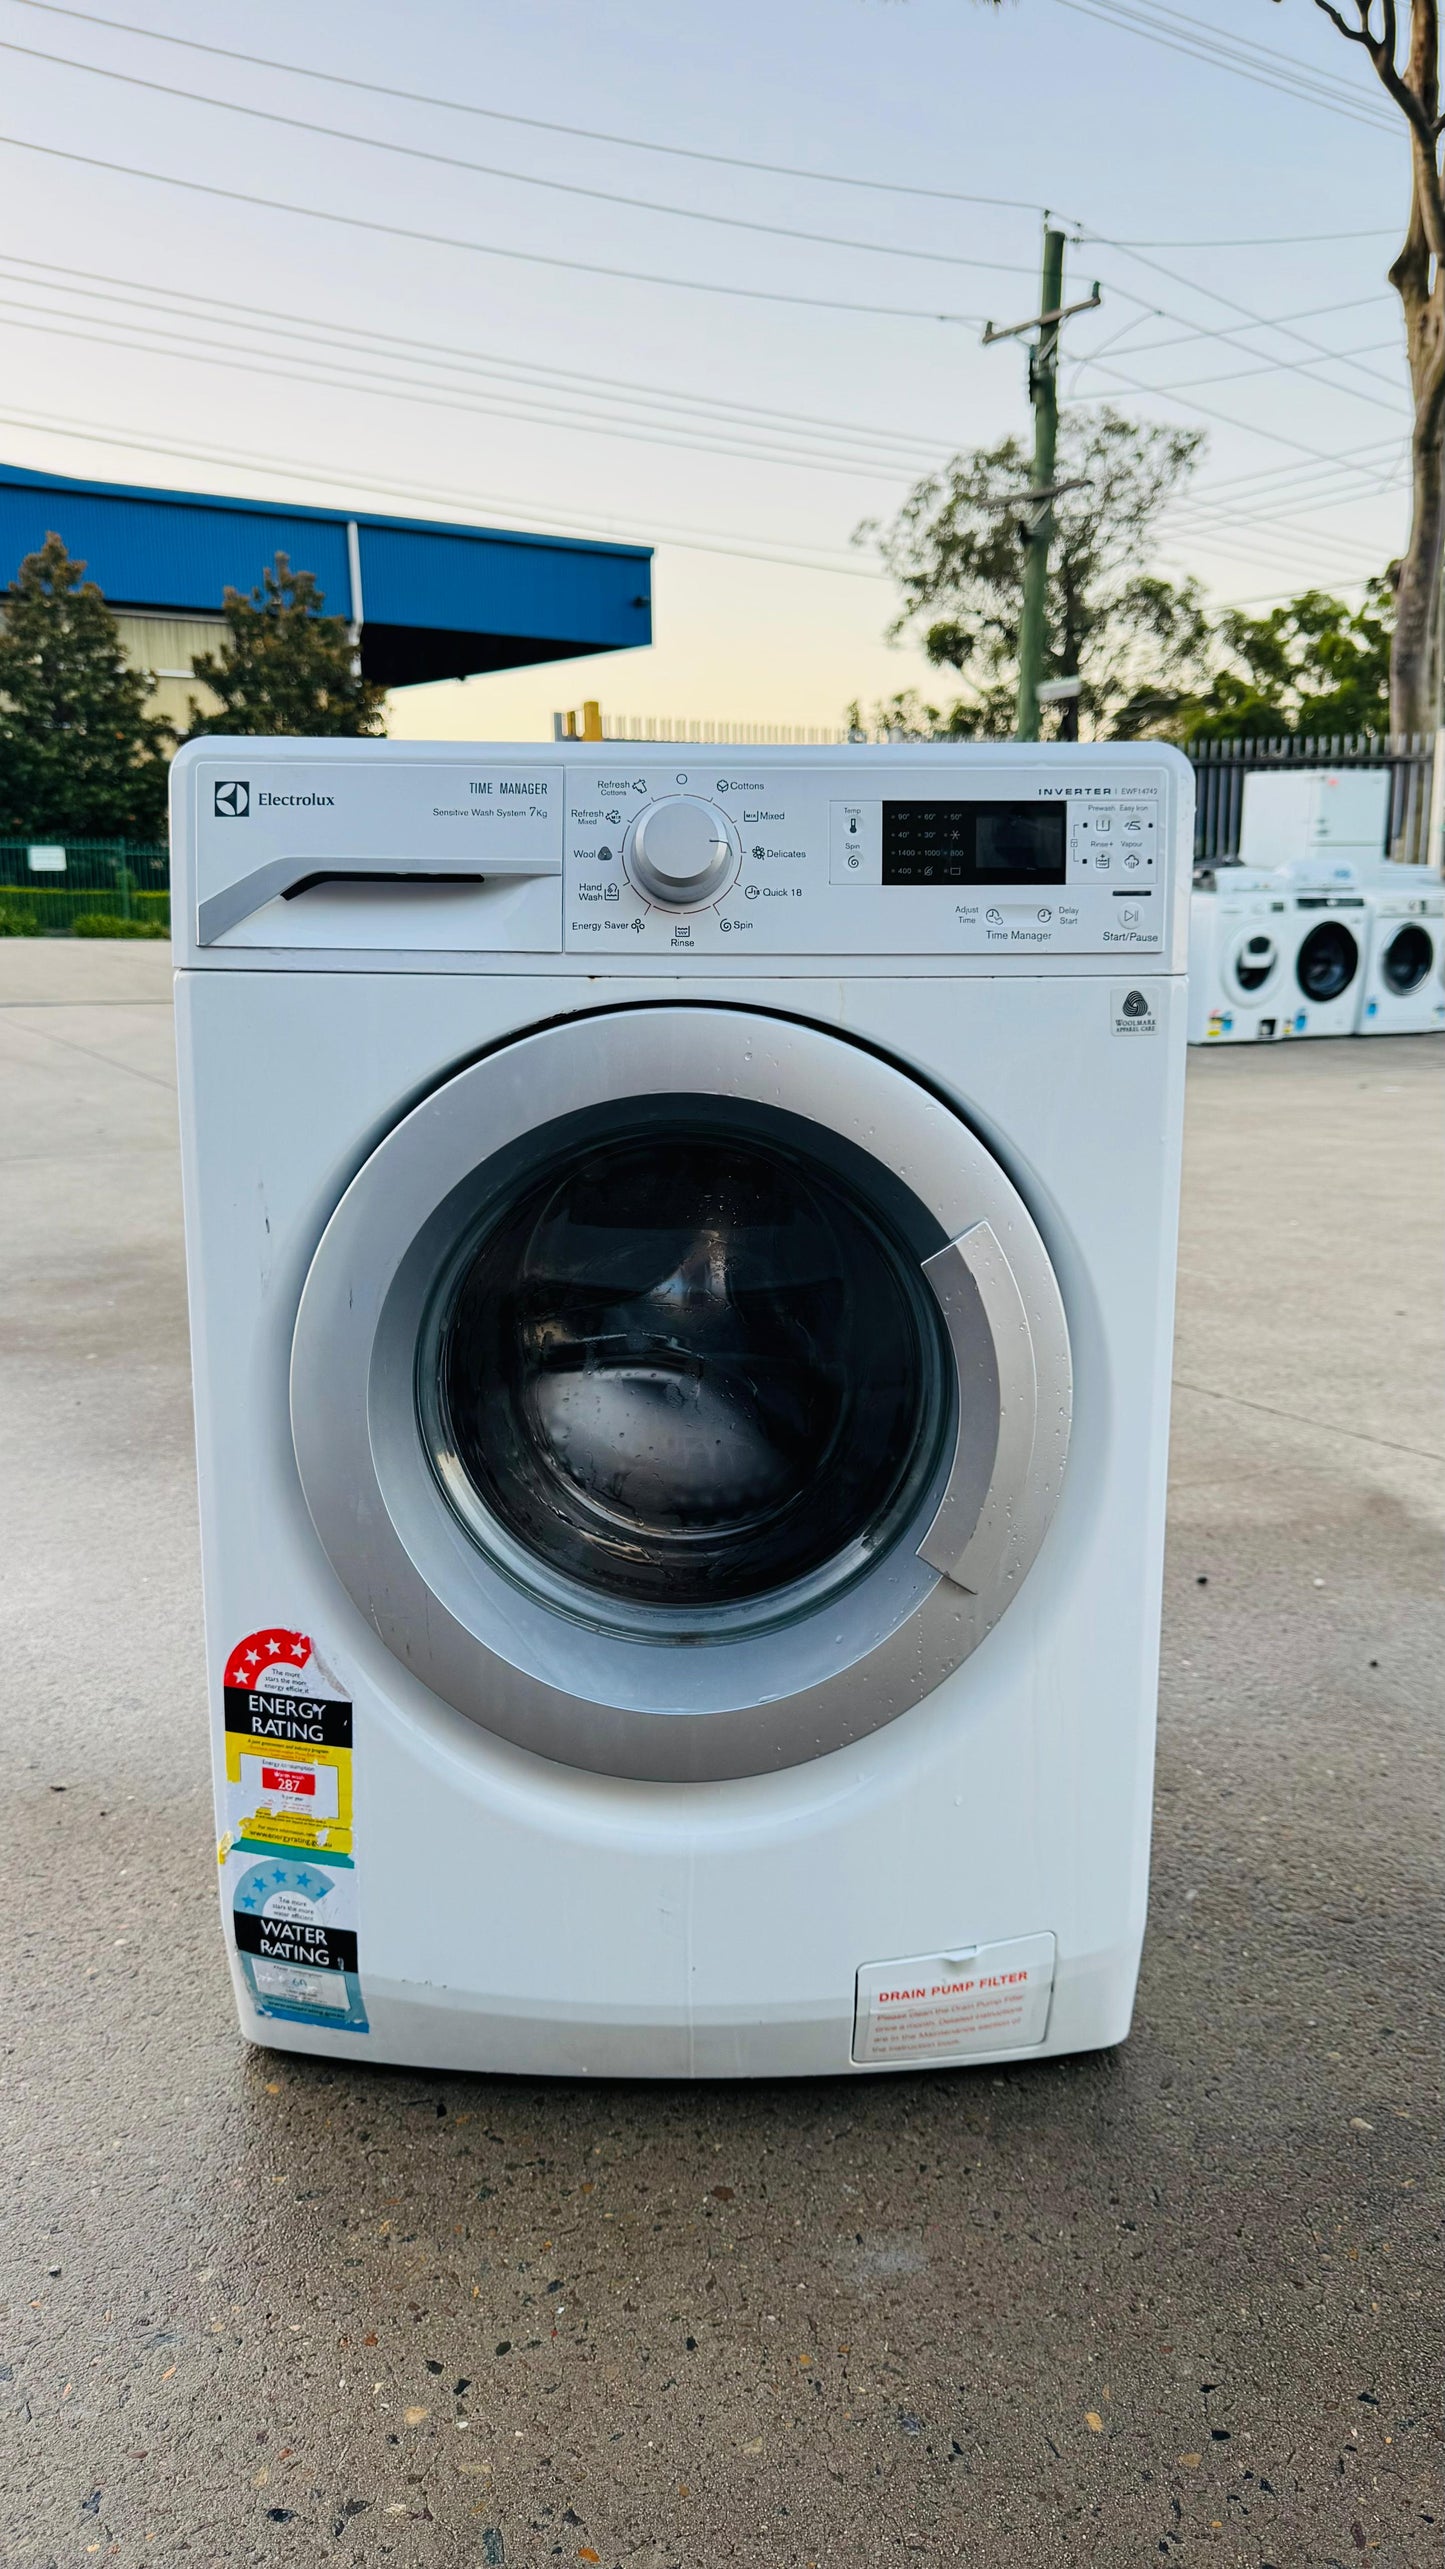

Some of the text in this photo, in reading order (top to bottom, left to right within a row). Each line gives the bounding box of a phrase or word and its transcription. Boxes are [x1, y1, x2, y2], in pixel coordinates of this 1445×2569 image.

[469, 782, 548, 795] TIME MANAGER
[597, 780, 630, 789] Refresh
[730, 781, 765, 790] Cottons
[1038, 788, 1112, 796] INVERTER
[258, 792, 335, 806] Electrolux
[432, 807, 469, 817] Sensitive
[471, 808, 494, 817] Wash
[496, 808, 527, 818] System
[844, 807, 862, 815] Temp
[1087, 804, 1116, 812] Prewash
[1119, 804, 1135, 813] Easy
[571, 809, 604, 818] Refresh
[759, 811, 785, 821] Mixed
[845, 842, 860, 850] Spin
[1120, 840, 1143, 849] Vapour
[573, 849, 596, 859] Wool
[766, 849, 807, 858] Delicates
[923, 849, 941, 857] 1000
[579, 882, 602, 891] Hand
[762, 887, 803, 897] Quick 18
[578, 892, 603, 902] Wash
[955, 906, 979, 915] Adjust
[1058, 906, 1080, 915] Delay
[958, 916, 976, 924] Time
[1059, 917, 1078, 925] Start
[572, 920, 629, 932] Energy Saver
[733, 920, 754, 931] Spin
[986, 930, 1052, 942] Time Manager
[1102, 931, 1159, 943] Start/Pause
[670, 938, 695, 947] Rinse
[271, 1668, 283, 1676] The
[264, 1683, 284, 1692] energy
[248, 1694, 326, 1721] ENERGY
[251, 1716, 324, 1742] RATING
[262, 1759, 280, 1768] Energy
[277, 1777, 301, 1792] 287
[260, 1918, 328, 1947] WATER
[260, 1938, 330, 1966] RATING
[878, 1970, 1028, 2002] DRAIN PUMP FILTER
[876, 2012, 907, 2021] Please
[935, 2006, 949, 2014] the
[951, 2002, 975, 2012] Drain
[976, 1999, 1002, 2009] Pump
[901, 2032, 917, 2040] the
